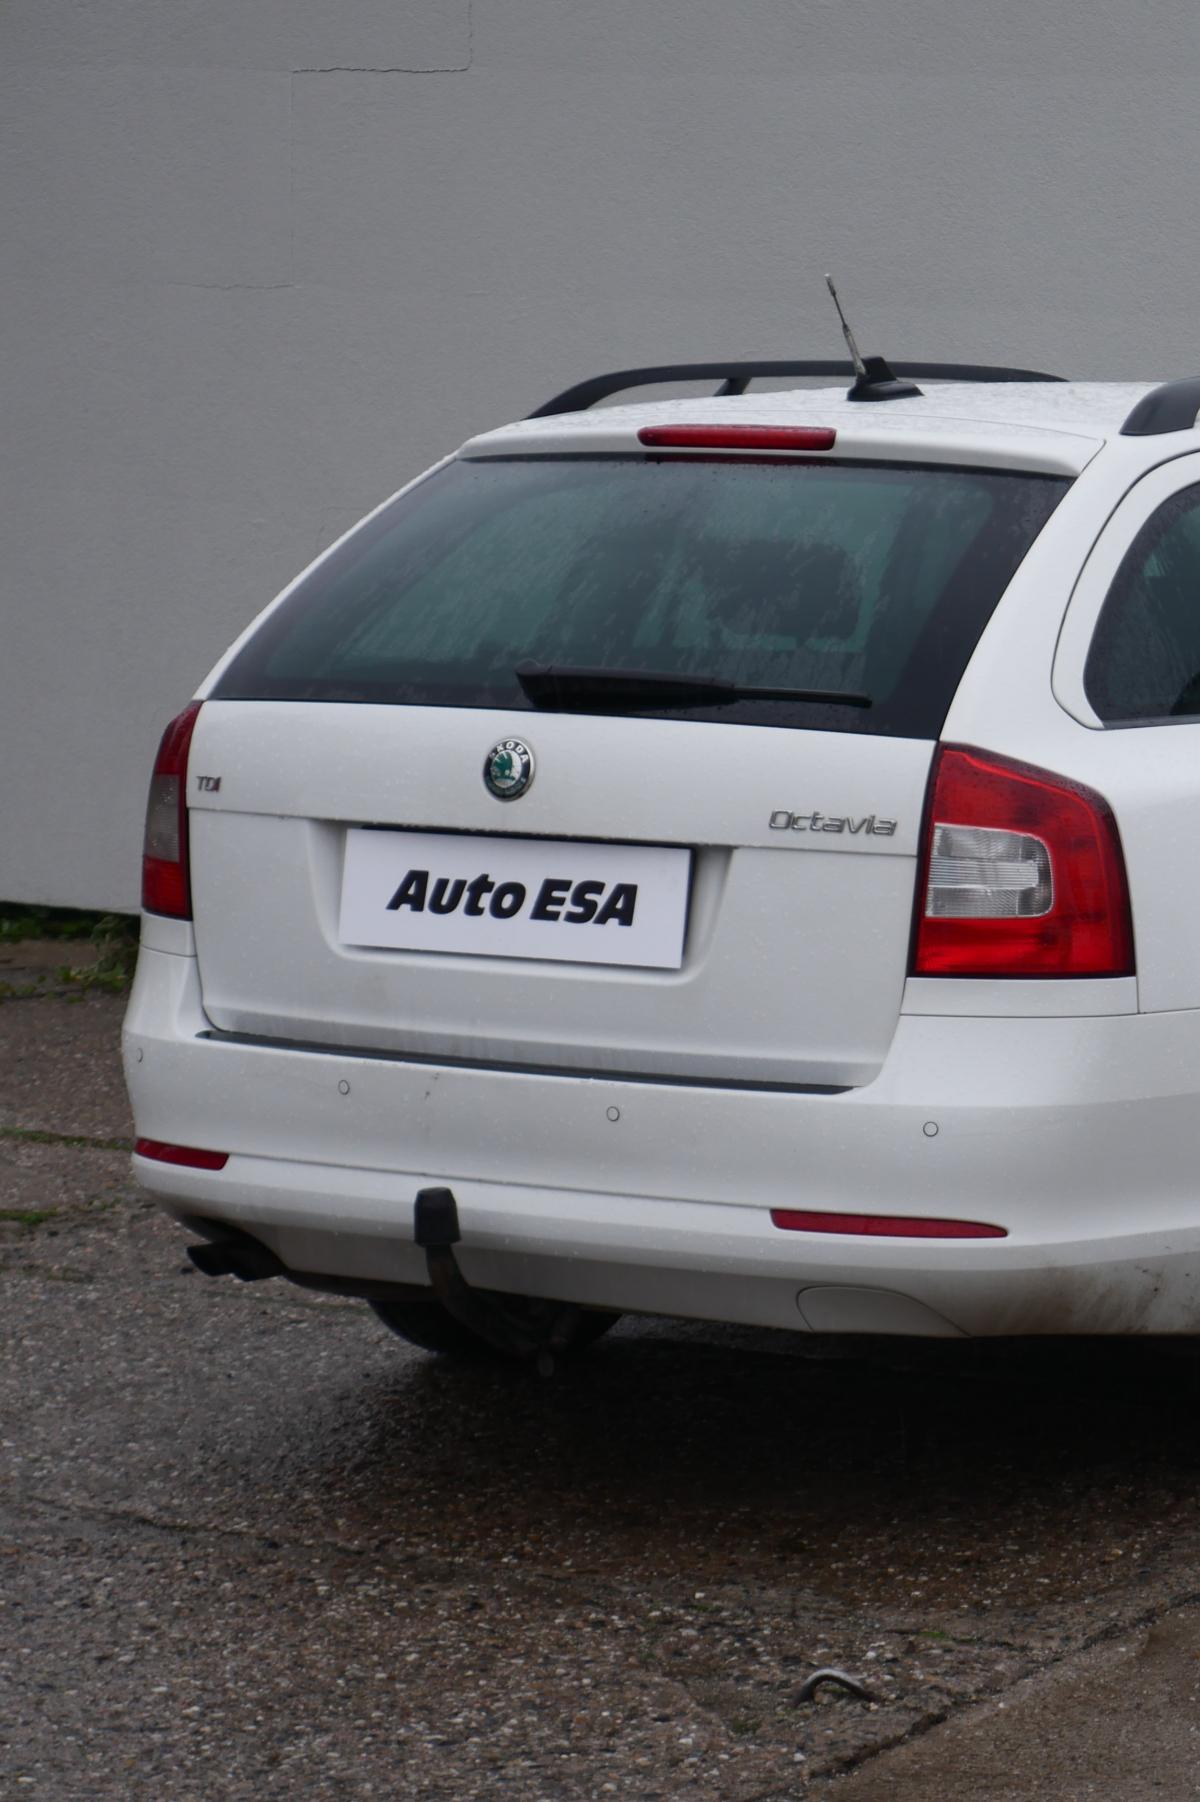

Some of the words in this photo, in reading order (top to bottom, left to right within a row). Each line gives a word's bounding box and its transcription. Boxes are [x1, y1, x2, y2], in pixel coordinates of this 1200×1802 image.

[196, 776, 221, 791] TDI
[769, 810, 897, 836] Octavia
[386, 869, 527, 920] Auto
[529, 878, 638, 927] ESA
